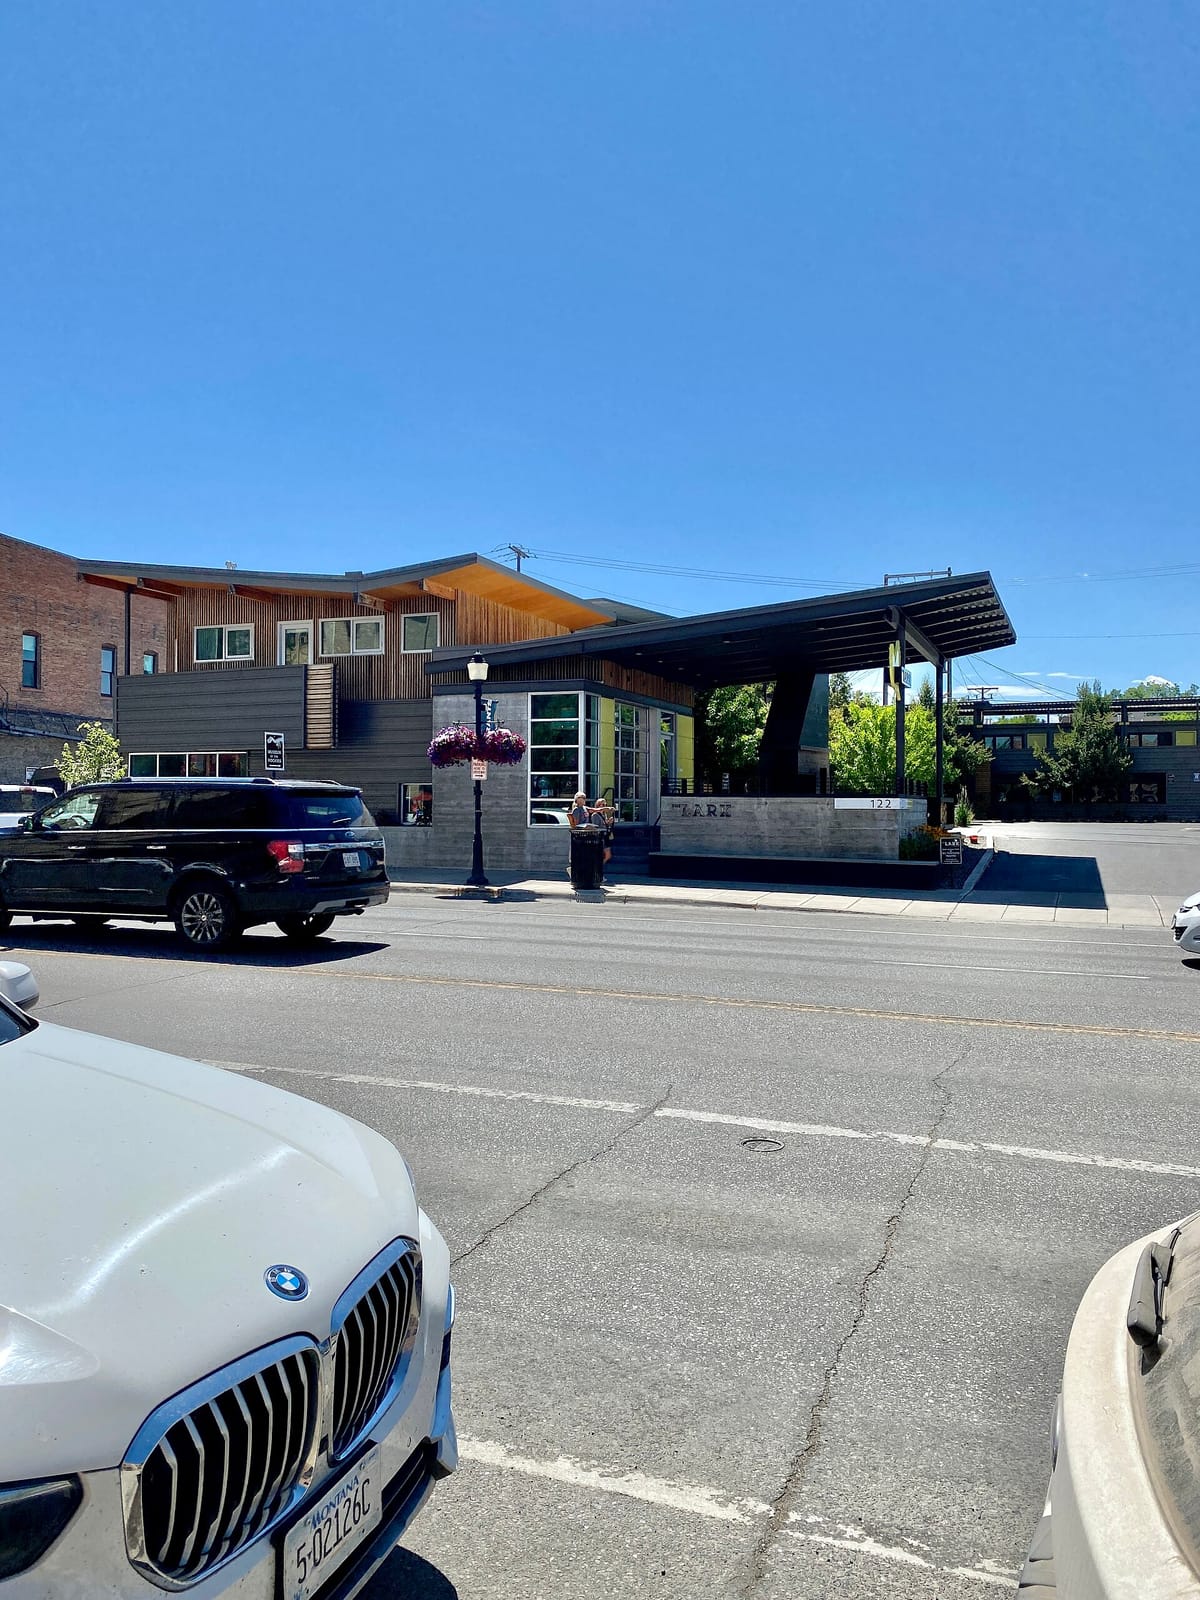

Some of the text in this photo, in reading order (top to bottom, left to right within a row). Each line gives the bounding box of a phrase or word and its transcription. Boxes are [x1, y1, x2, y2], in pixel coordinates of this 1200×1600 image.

[870, 799, 891, 808] 122
[680, 804, 732, 818] LARK
[311, 1475, 360, 1529] MONTANA
